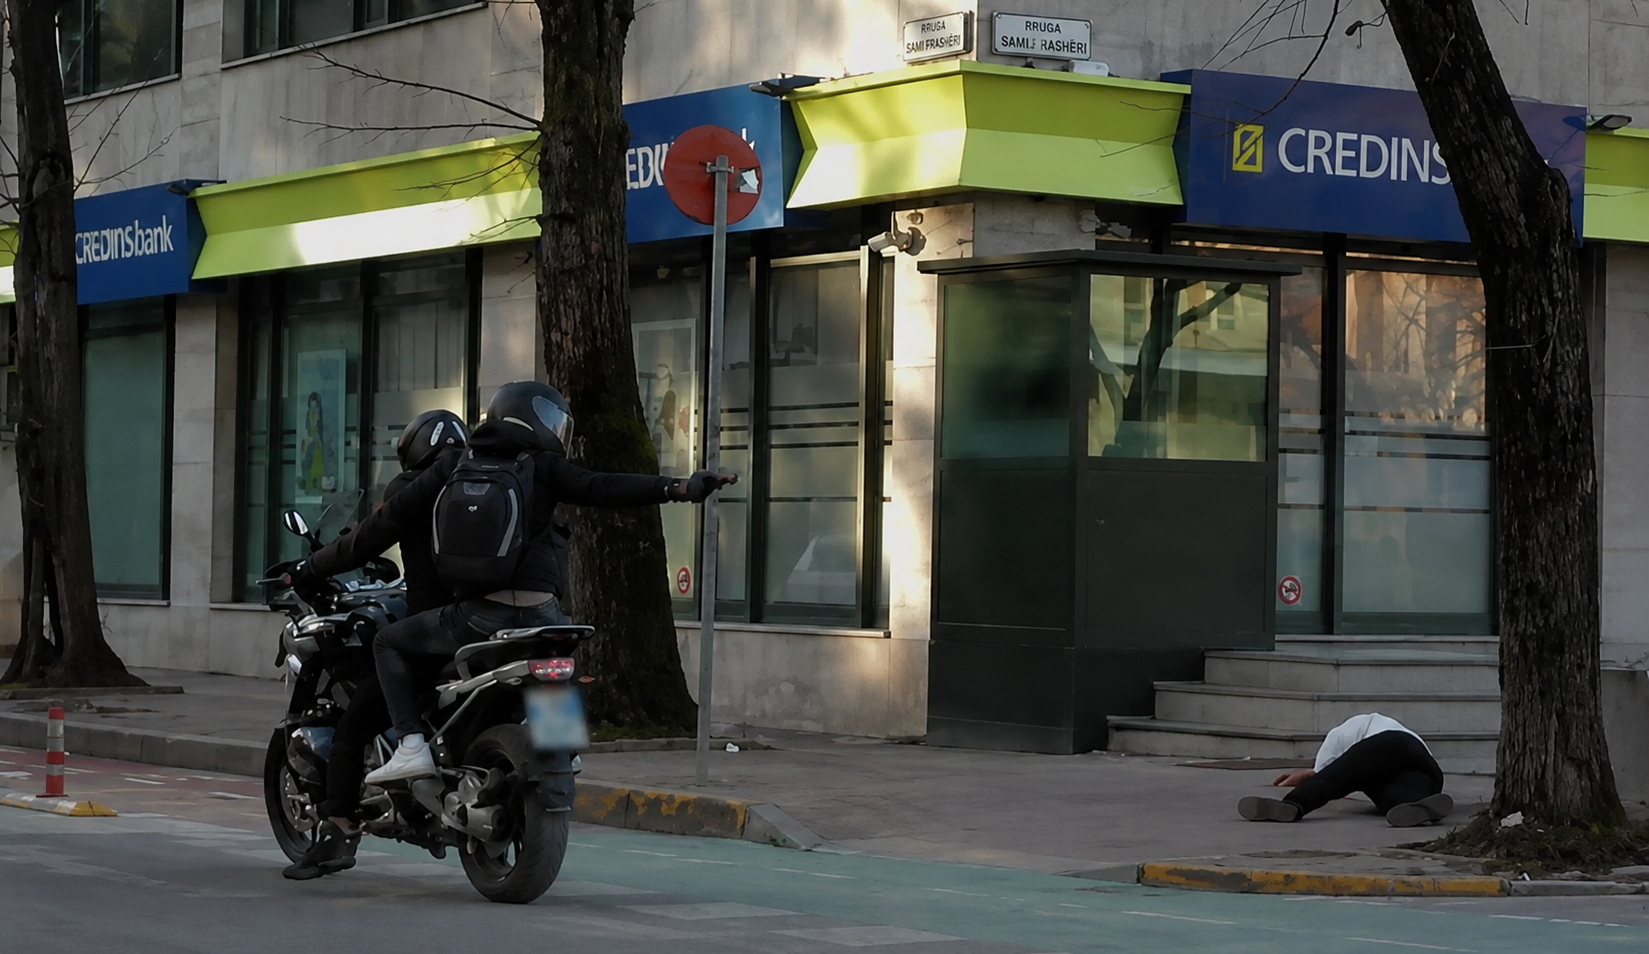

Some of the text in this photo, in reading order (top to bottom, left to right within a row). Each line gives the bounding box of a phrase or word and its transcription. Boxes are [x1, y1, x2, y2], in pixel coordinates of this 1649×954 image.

[921, 20, 946, 34] RRUGA
[1025, 21, 1062, 34] RRUGA
[906, 40, 925, 54] SAMI
[1001, 35, 1029, 49] SAMI
[1278, 127, 1451, 185] CREDINS
